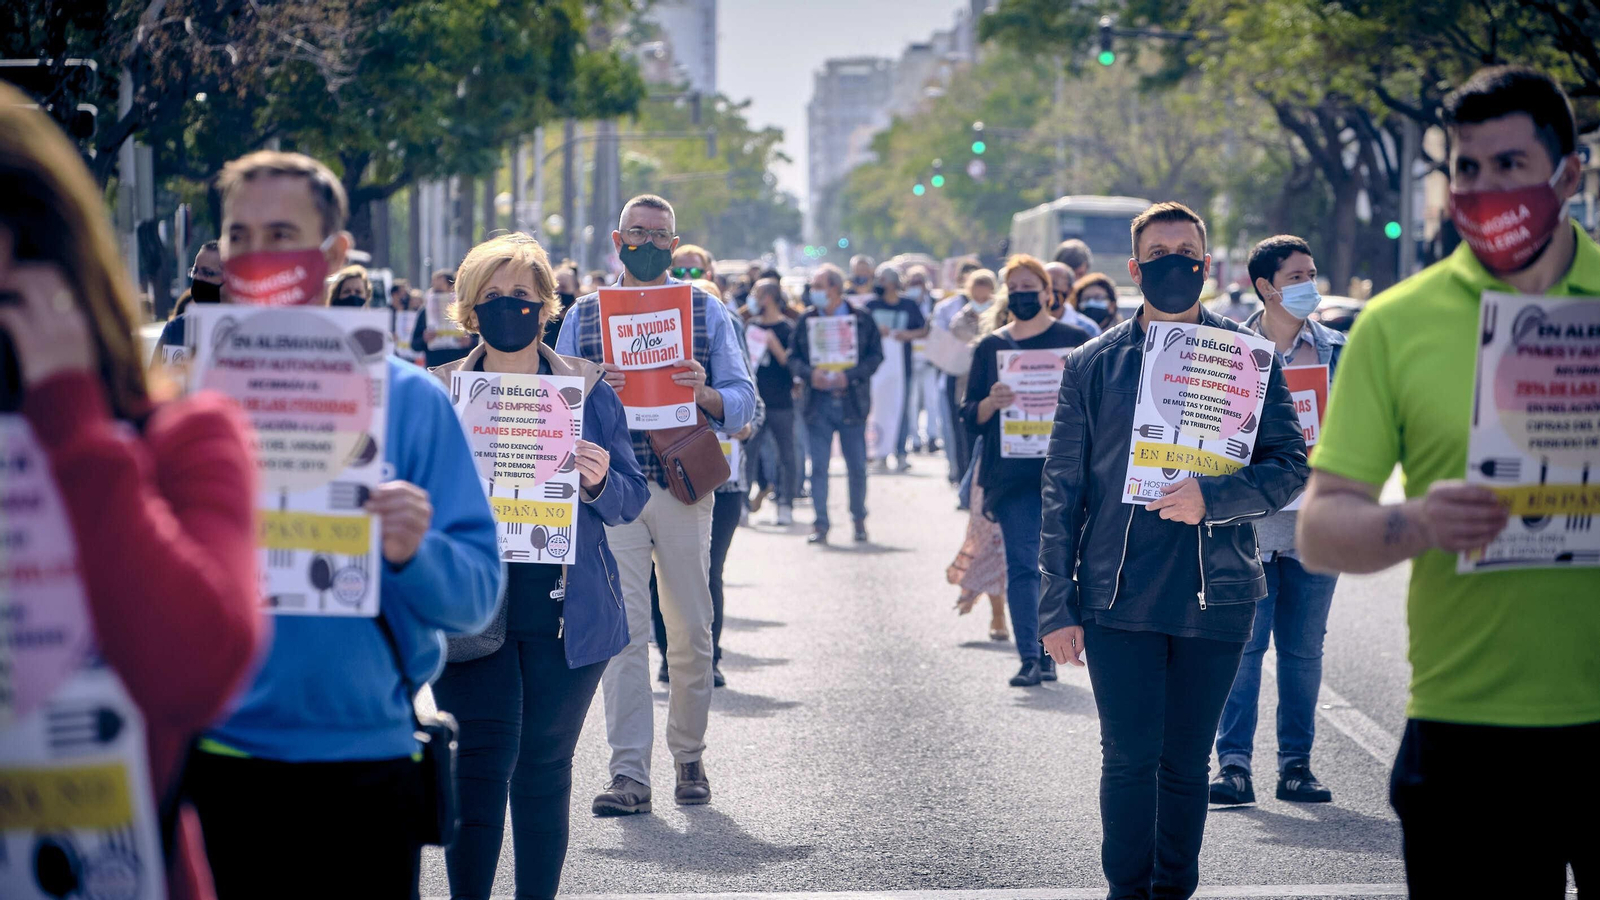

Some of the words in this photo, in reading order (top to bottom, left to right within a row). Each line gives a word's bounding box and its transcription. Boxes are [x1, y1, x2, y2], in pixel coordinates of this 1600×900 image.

[617, 324, 633, 338] SIN
[637, 318, 676, 336] AYUDAS
[1539, 324, 1561, 338] EN
[631, 332, 663, 353] Nos
[1186, 337, 1199, 346] EN
[1202, 339, 1241, 355] BÉLGICA
[621, 344, 679, 366] Arruinan!
[1180, 351, 1196, 360] LAS
[1198, 354, 1243, 370] EMPRESAS
[1182, 366, 1207, 374] PUEDEN
[1207, 370, 1236, 381] SOLICITAR
[491, 387, 504, 395] EN
[507, 386, 549, 398] BÉLGICA
[1164, 374, 1200, 386] PLANES
[1201, 380, 1250, 398] ESPECIALES
[1179, 391, 1198, 399] COMO
[1200, 395, 1231, 406] EXENCIÓN
[487, 402, 504, 410] LAS
[505, 402, 552, 412] EMPRESAS
[1172, 400, 1198, 409] MULTAS
[1213, 406, 1242, 419] INTERESES
[1195, 412, 1222, 423] DEMORA
[473, 426, 509, 436] PLANES
[511, 428, 563, 438] ESPECIALES
[1190, 421, 1220, 432] TRIBUTOS.
[1140, 448, 1160, 460] EN
[1166, 451, 1219, 471] ESPAÑA
[493, 505, 538, 517] SPAÑA
[545, 508, 565, 518] NO
